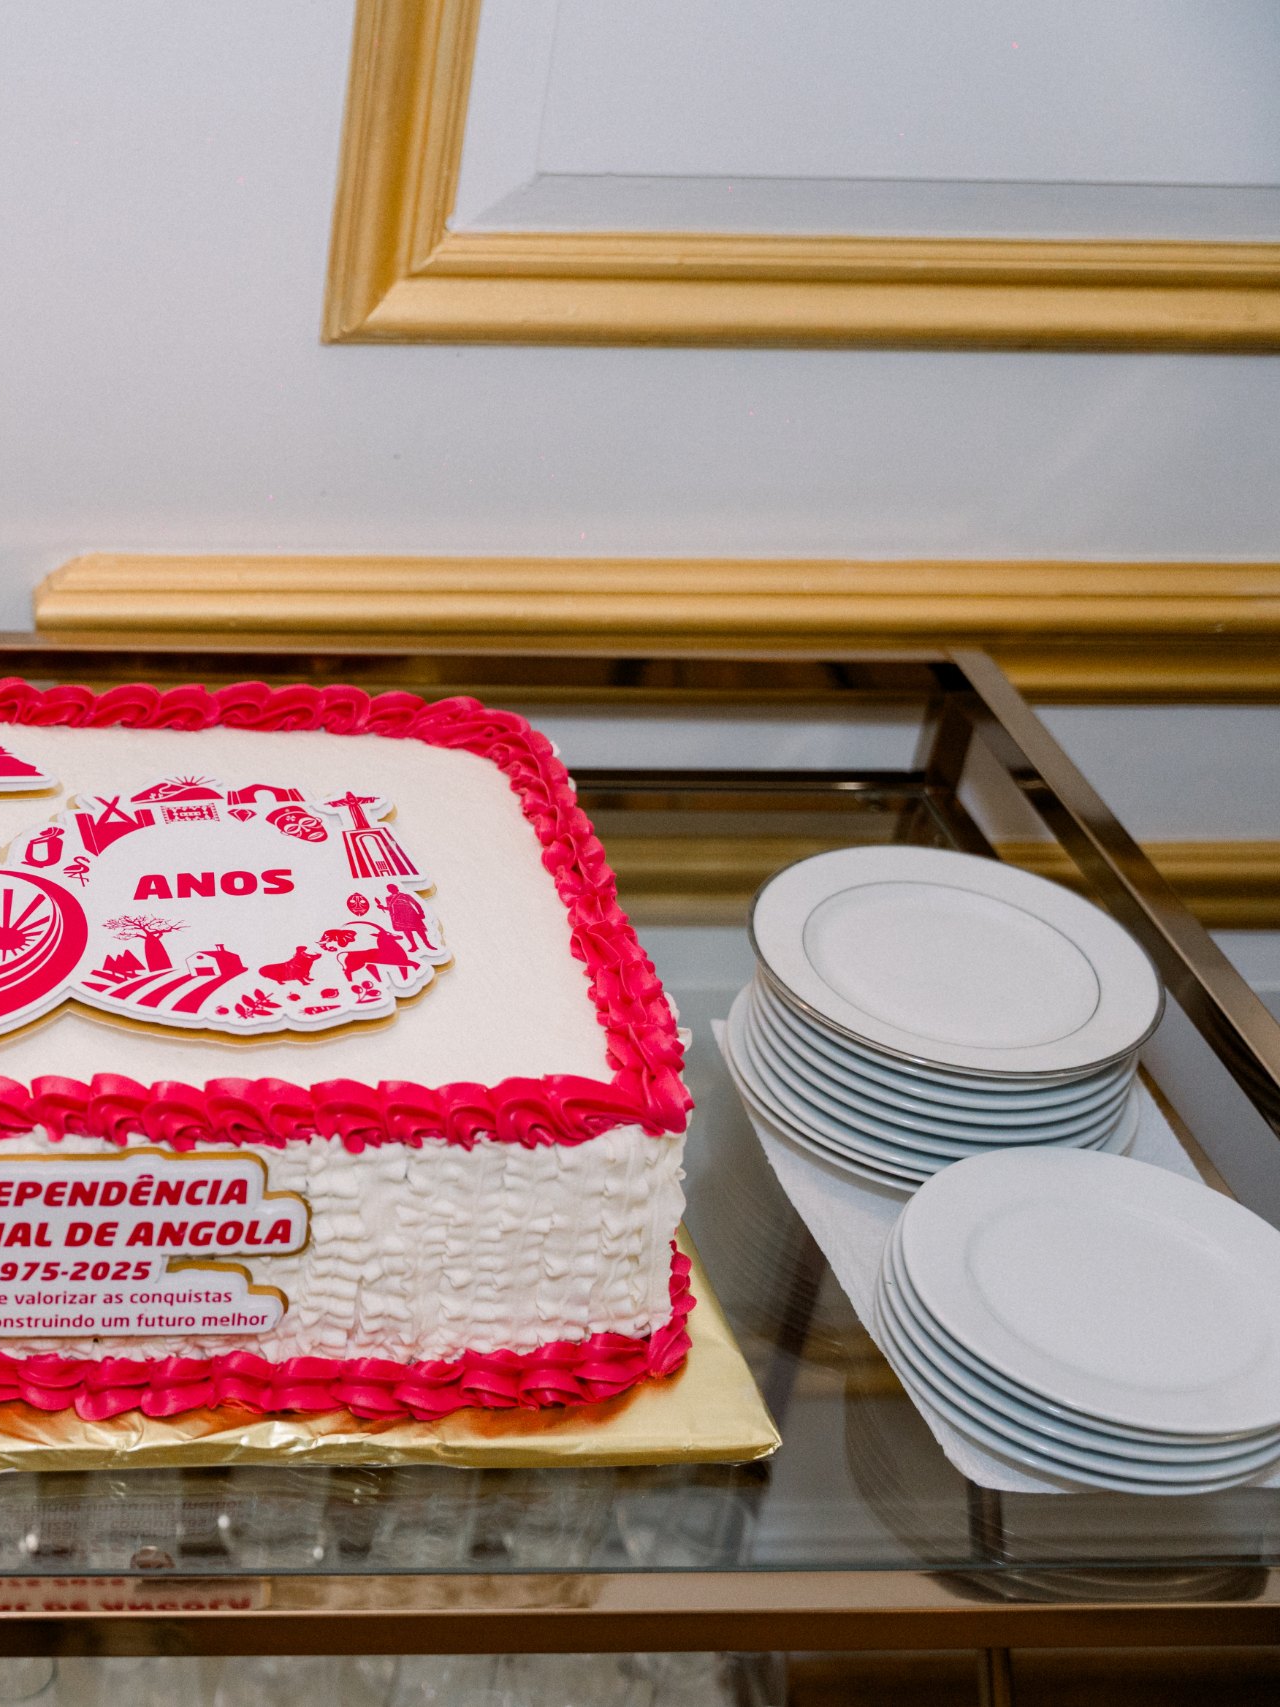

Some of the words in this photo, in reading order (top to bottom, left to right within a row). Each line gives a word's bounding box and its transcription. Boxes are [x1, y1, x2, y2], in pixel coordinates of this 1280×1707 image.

[133, 868, 295, 901] ANOS
[63, 1221, 119, 1248] DE
[125, 1218, 292, 1247] ANGOLA
[14, 1291, 96, 1305] valorizar
[102, 1293, 123, 1304] as
[130, 1291, 232, 1307] conquistas
[101, 1317, 130, 1328] um
[137, 1314, 195, 1328] futuro
[201, 1313, 267, 1327] melhor
